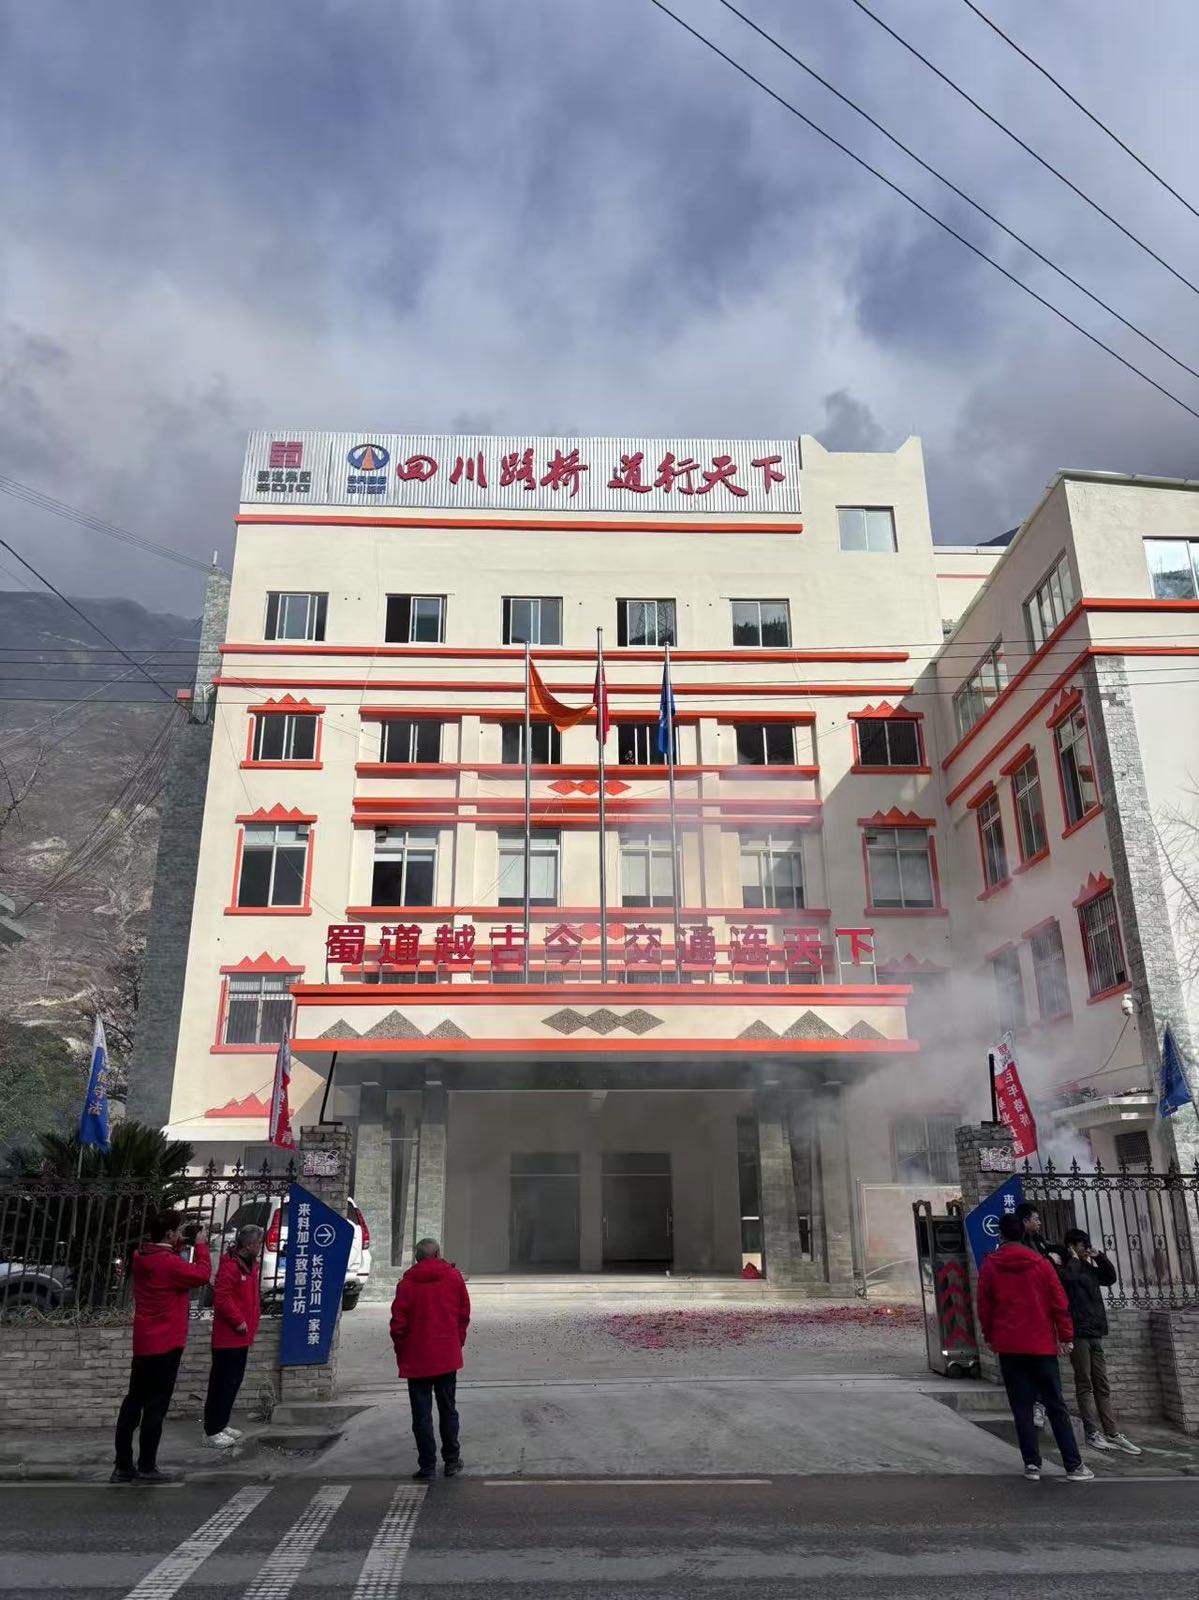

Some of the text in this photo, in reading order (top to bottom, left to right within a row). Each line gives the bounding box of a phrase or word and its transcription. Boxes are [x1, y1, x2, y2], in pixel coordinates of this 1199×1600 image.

[256, 483, 311, 493] SDIG
[396, 447, 786, 497] 四川路桥 道行天下
[326, 924, 875, 967] 蜀道越古今 交通连天下
[292, 1203, 311, 1314] 来料加工致富工坊
[307, 1254, 324, 1345] 长兴汶川一家亲
